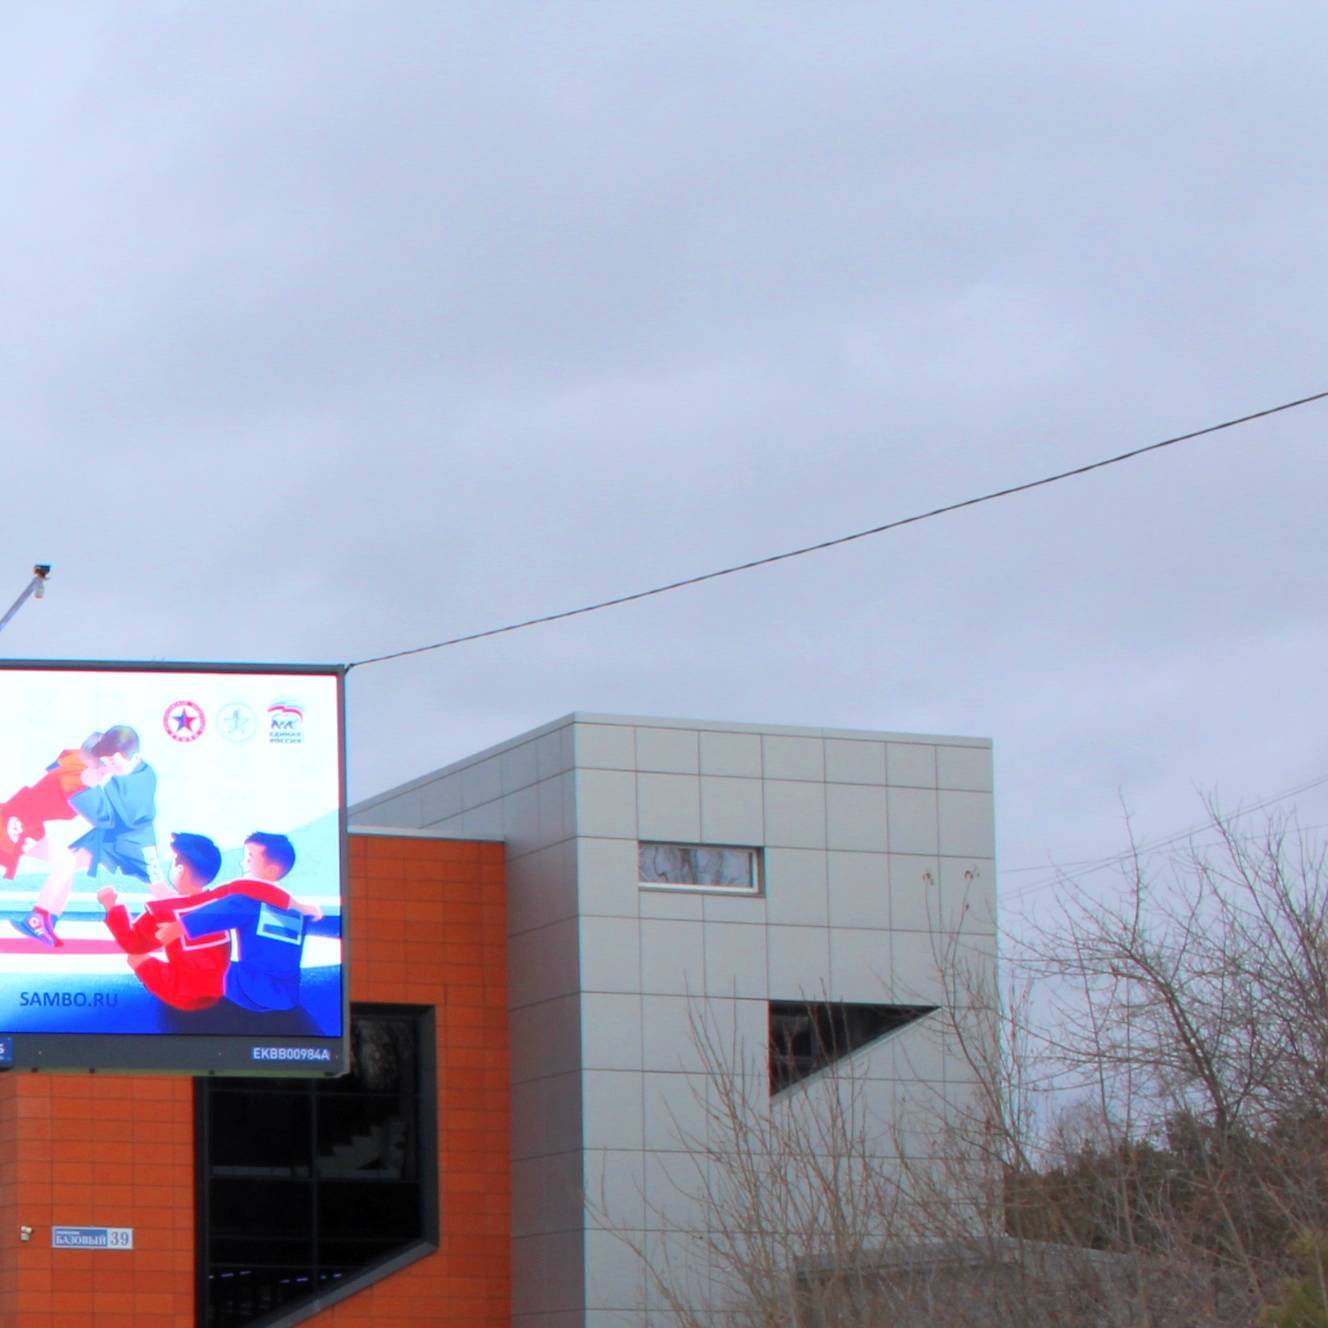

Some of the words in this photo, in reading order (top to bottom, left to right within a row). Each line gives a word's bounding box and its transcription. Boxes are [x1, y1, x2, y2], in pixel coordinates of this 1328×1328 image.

[19, 991, 119, 1008] SAMBO.RU
[252, 1047, 331, 1061] EKBB00984A
[55, 1234, 106, 1245] БАЗОВЫЙ
[111, 1231, 129, 1246] 39
